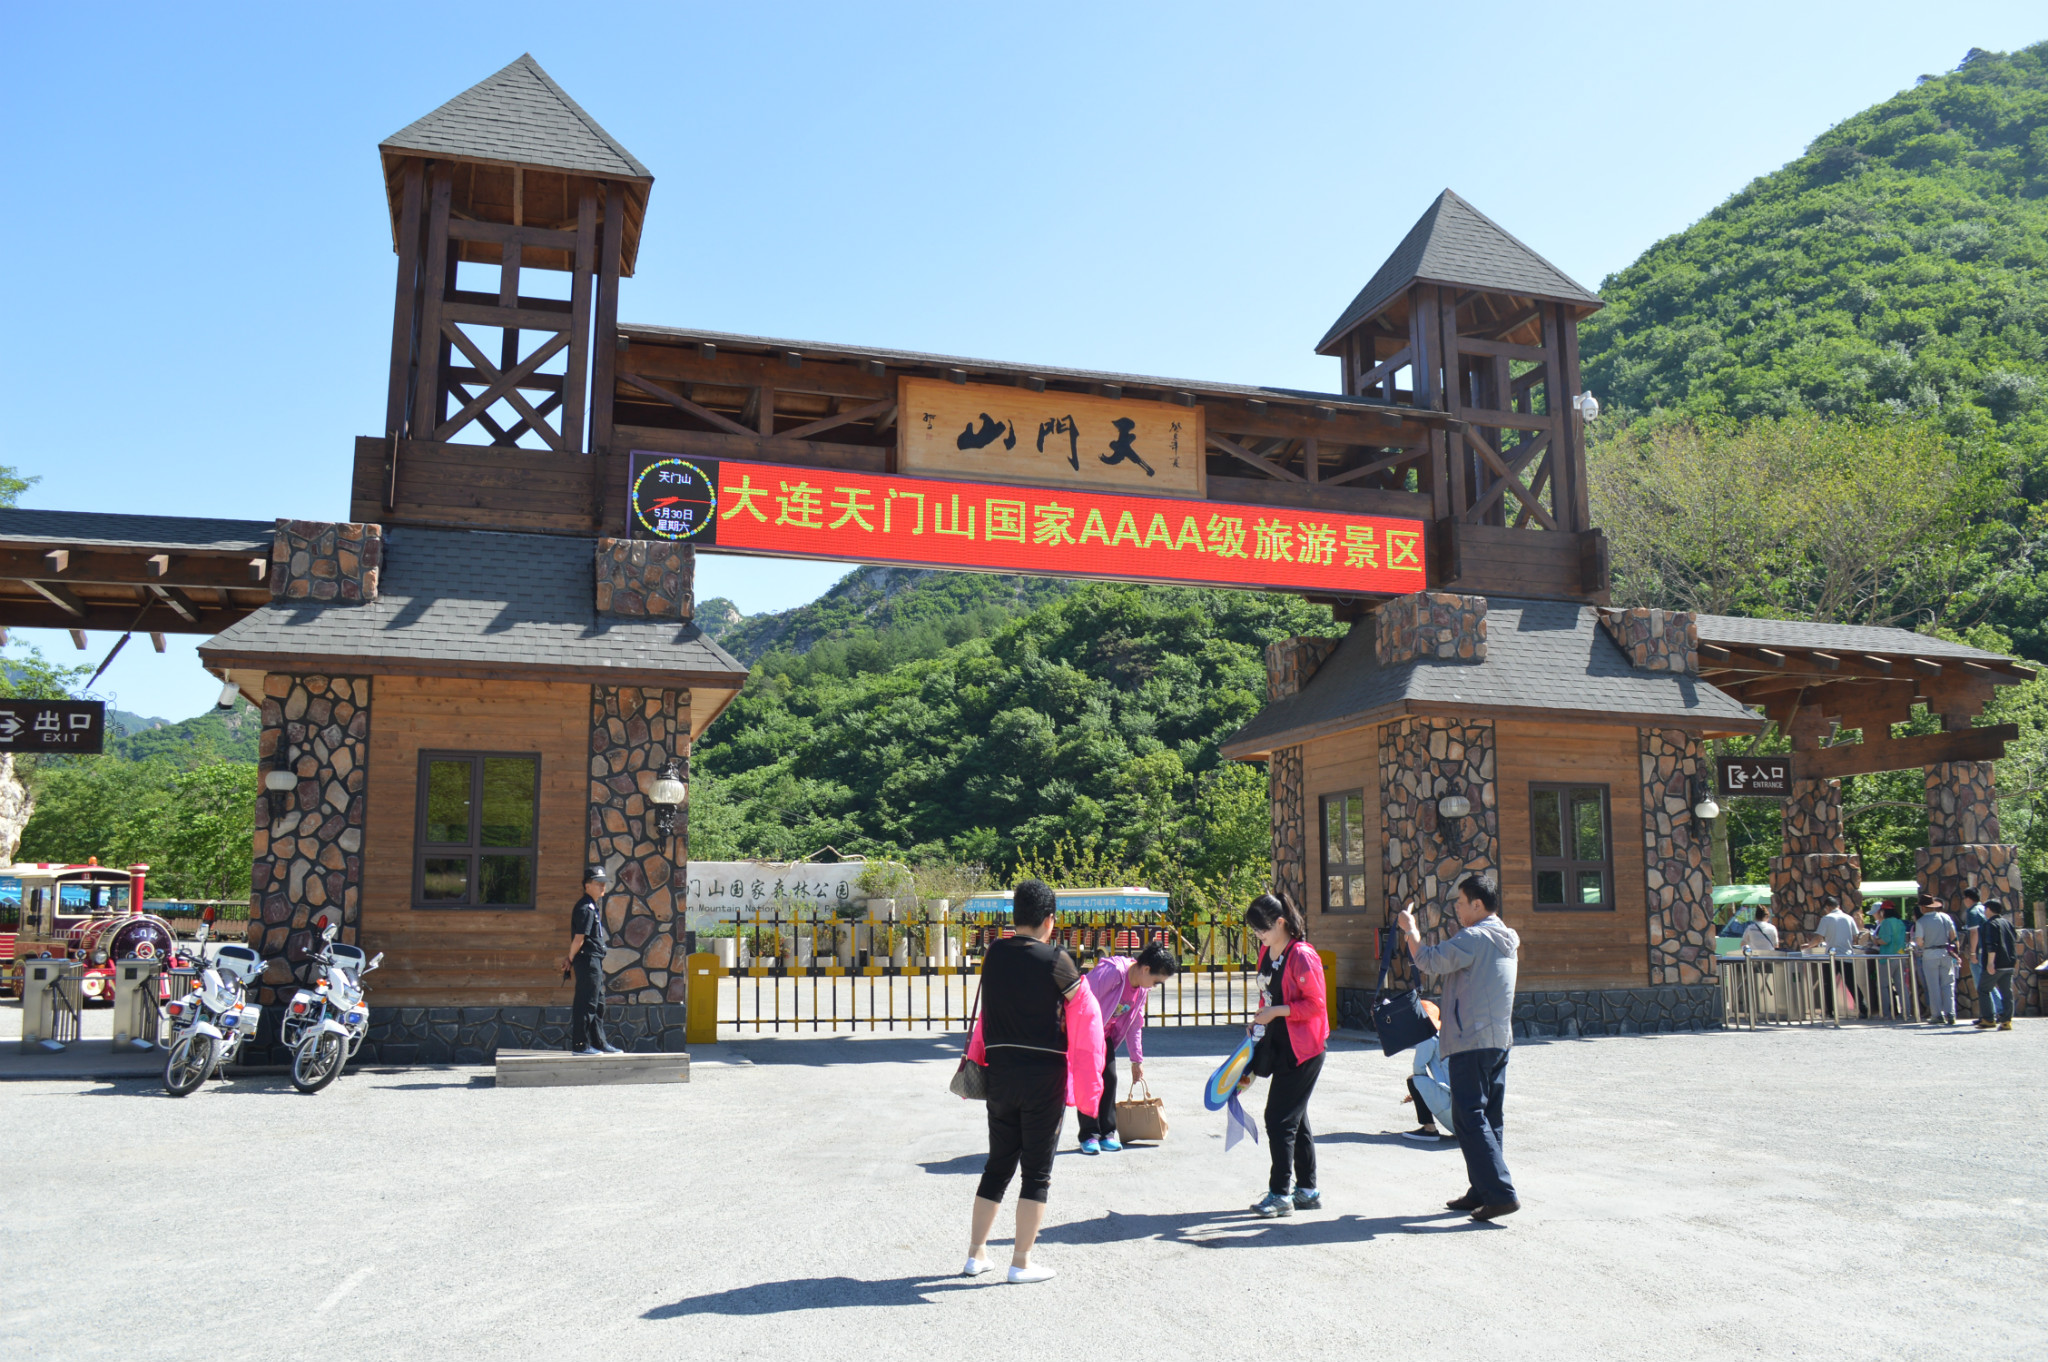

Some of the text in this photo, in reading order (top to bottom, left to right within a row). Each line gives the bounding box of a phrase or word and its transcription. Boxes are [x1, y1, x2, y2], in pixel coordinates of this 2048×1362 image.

[658, 470, 692, 485] 天门山
[654, 507, 693, 520] 5月30日
[657, 519, 690, 533] 星期六
[720, 475, 1422, 573] 大连天门山国家AAAA级旅游景区
[34, 710, 91, 731] 出口
[43, 733, 80, 742] EXIT
[1752, 765, 1784, 780] 入口
[1752, 781, 1784, 789] ENTRANCE
[698, 904, 740, 912] Mountain
